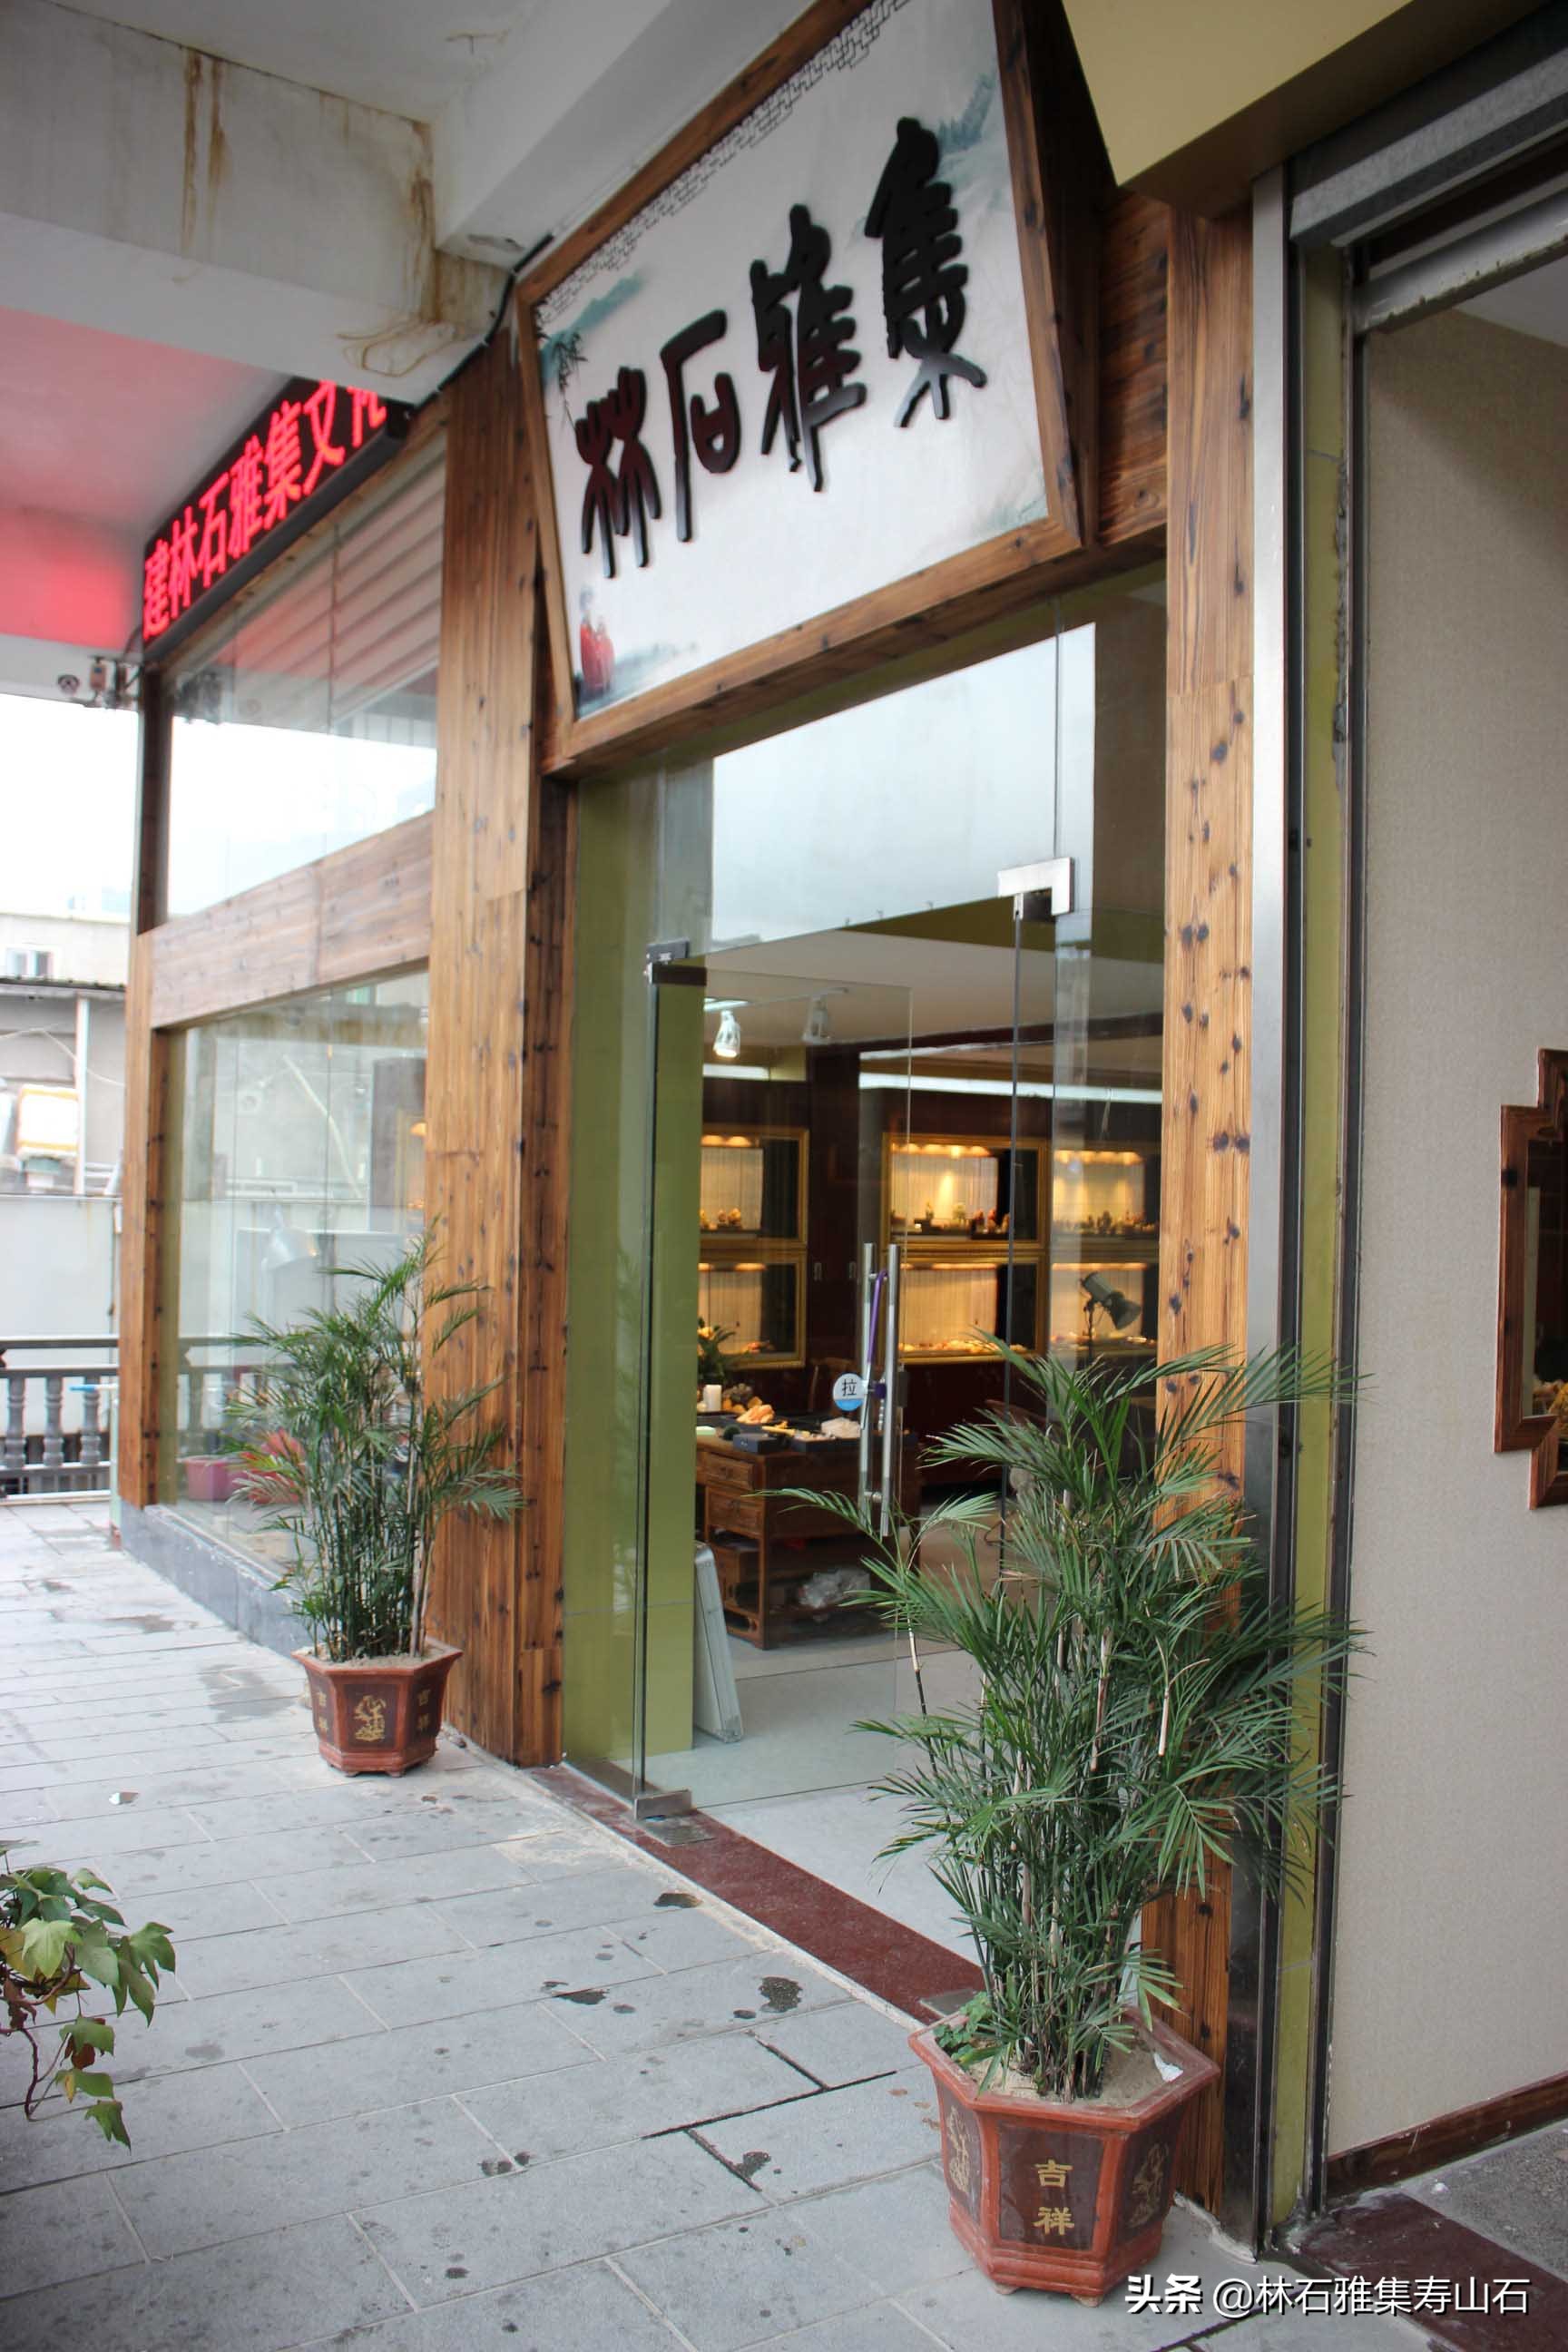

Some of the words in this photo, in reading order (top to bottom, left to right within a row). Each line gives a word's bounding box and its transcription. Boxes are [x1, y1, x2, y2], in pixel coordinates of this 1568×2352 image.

[574, 117, 986, 579] 林石雅集
[842, 1378, 858, 1396] 拉
[1033, 2159, 1074, 2236] 吉祥
